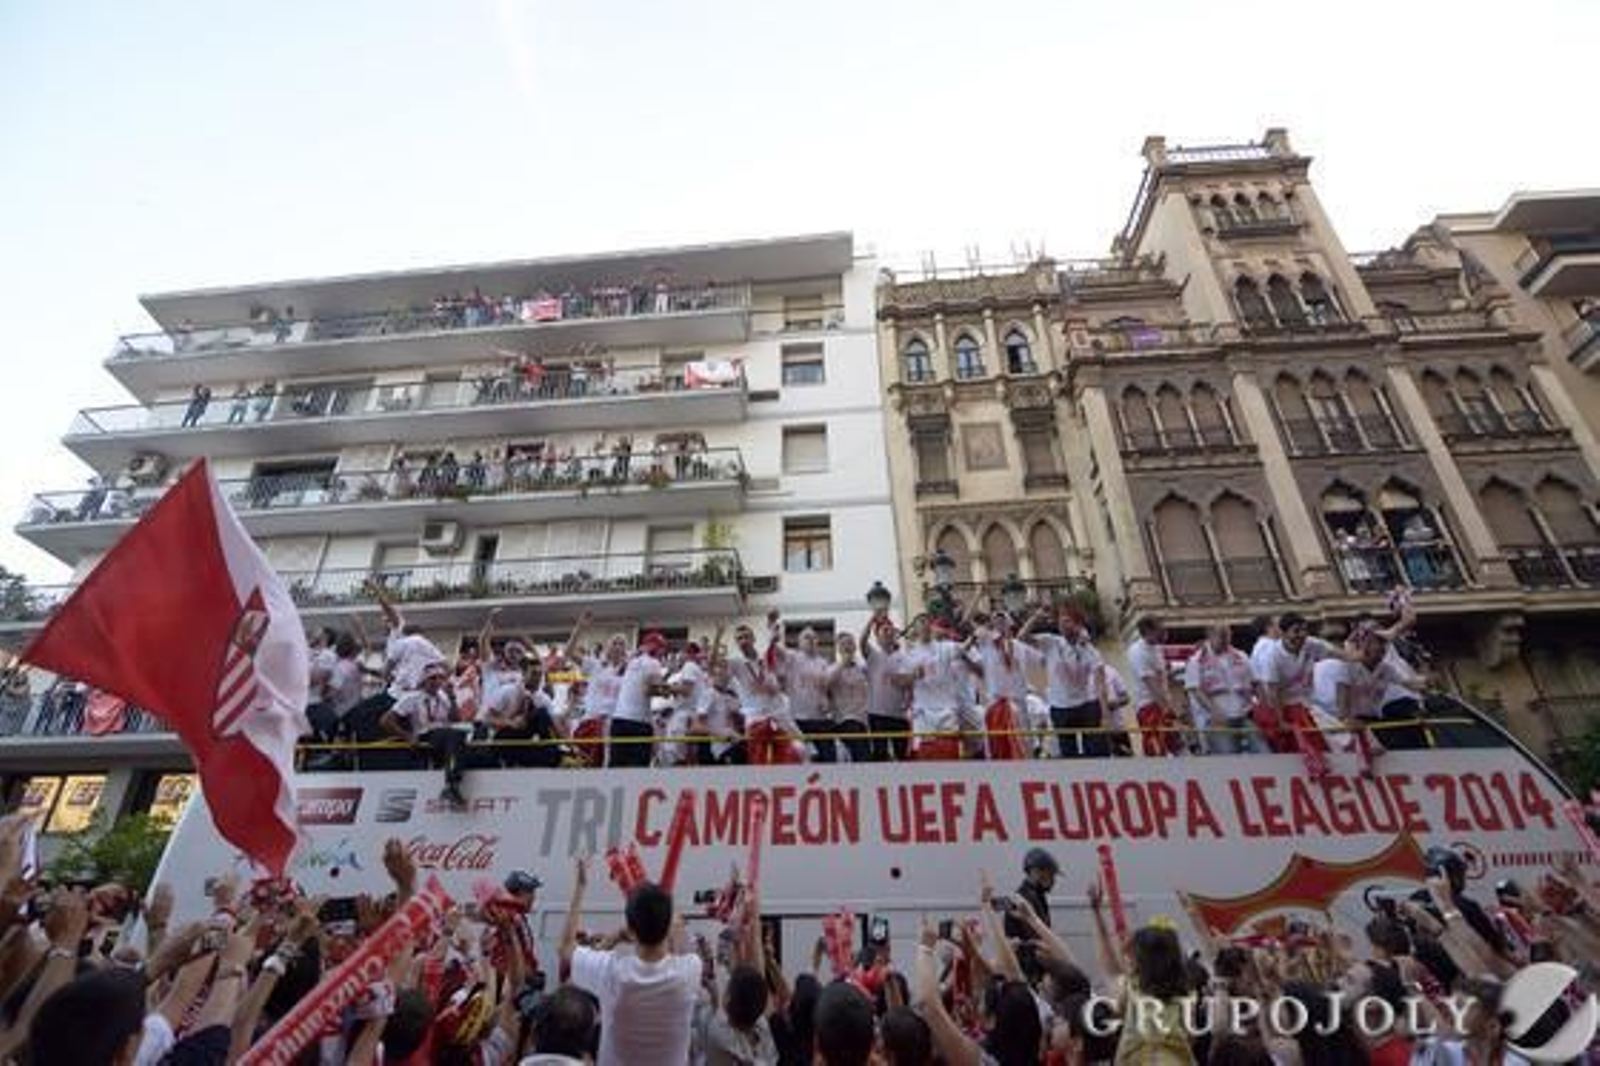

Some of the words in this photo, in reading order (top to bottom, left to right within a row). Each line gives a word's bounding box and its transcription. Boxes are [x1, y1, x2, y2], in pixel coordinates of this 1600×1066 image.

[536, 786, 625, 857] TRI
[635, 773, 861, 846] CAMPEÓN
[877, 780, 1008, 845] UEFA
[1021, 777, 1223, 842] EUROPA
[1229, 774, 1432, 838] LEAGUE
[1424, 771, 1557, 832] 2014
